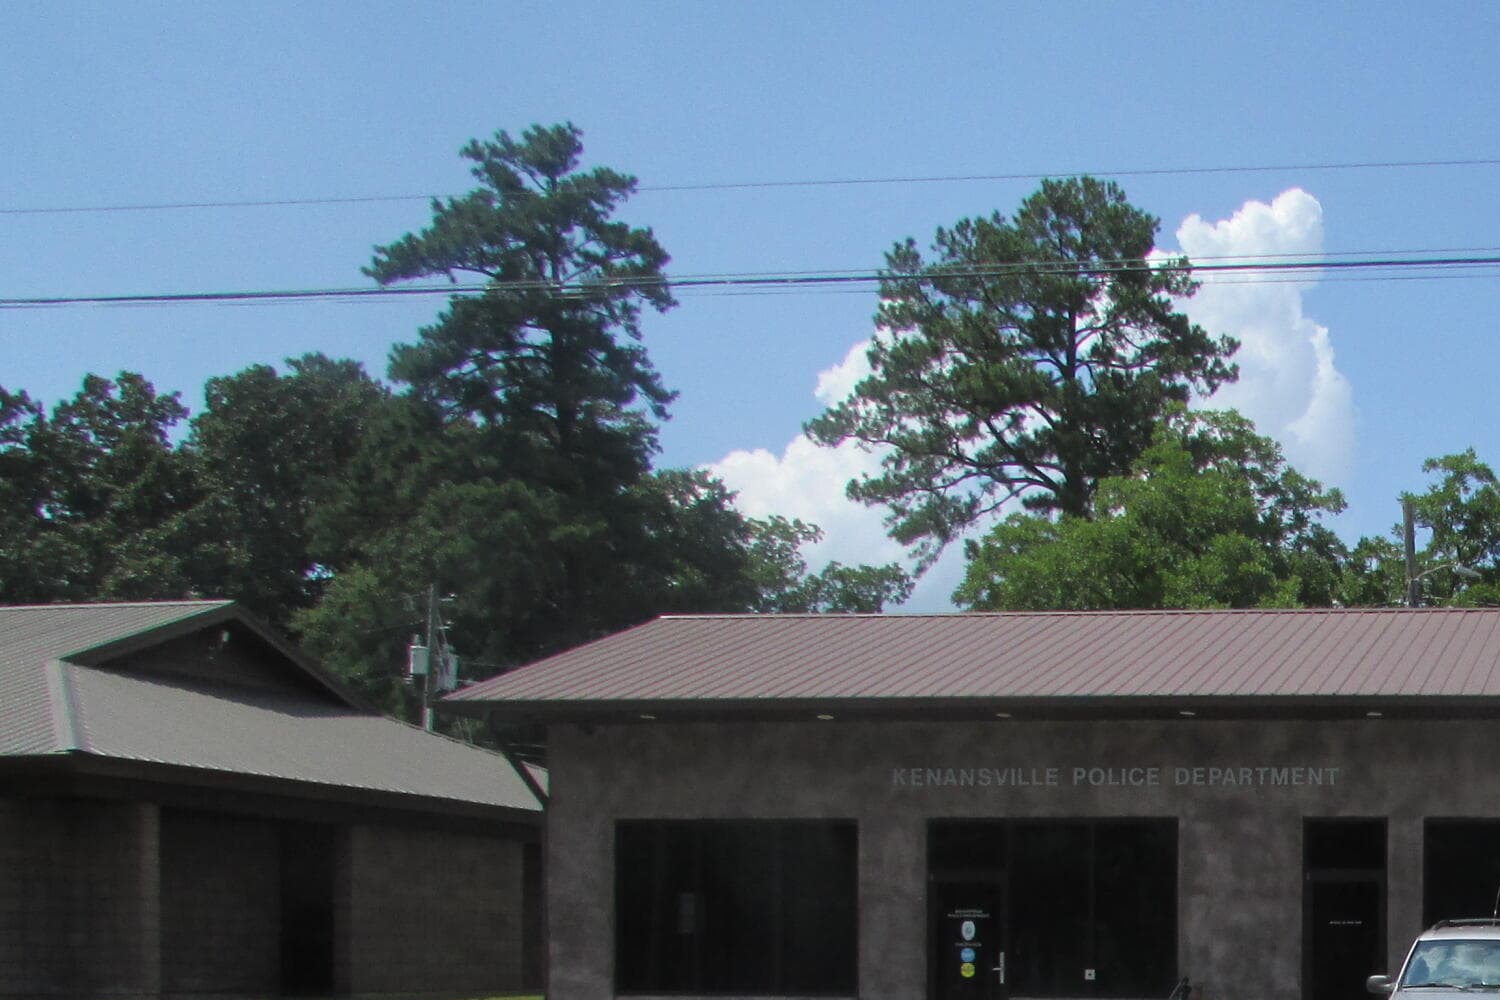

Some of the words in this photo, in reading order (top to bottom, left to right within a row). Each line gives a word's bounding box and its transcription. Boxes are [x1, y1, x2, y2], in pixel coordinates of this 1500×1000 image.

[892, 767, 1058, 786] KENANSVILLE
[1072, 767, 1160, 786] POLICE
[1174, 767, 1341, 786] DEPARTMENT
